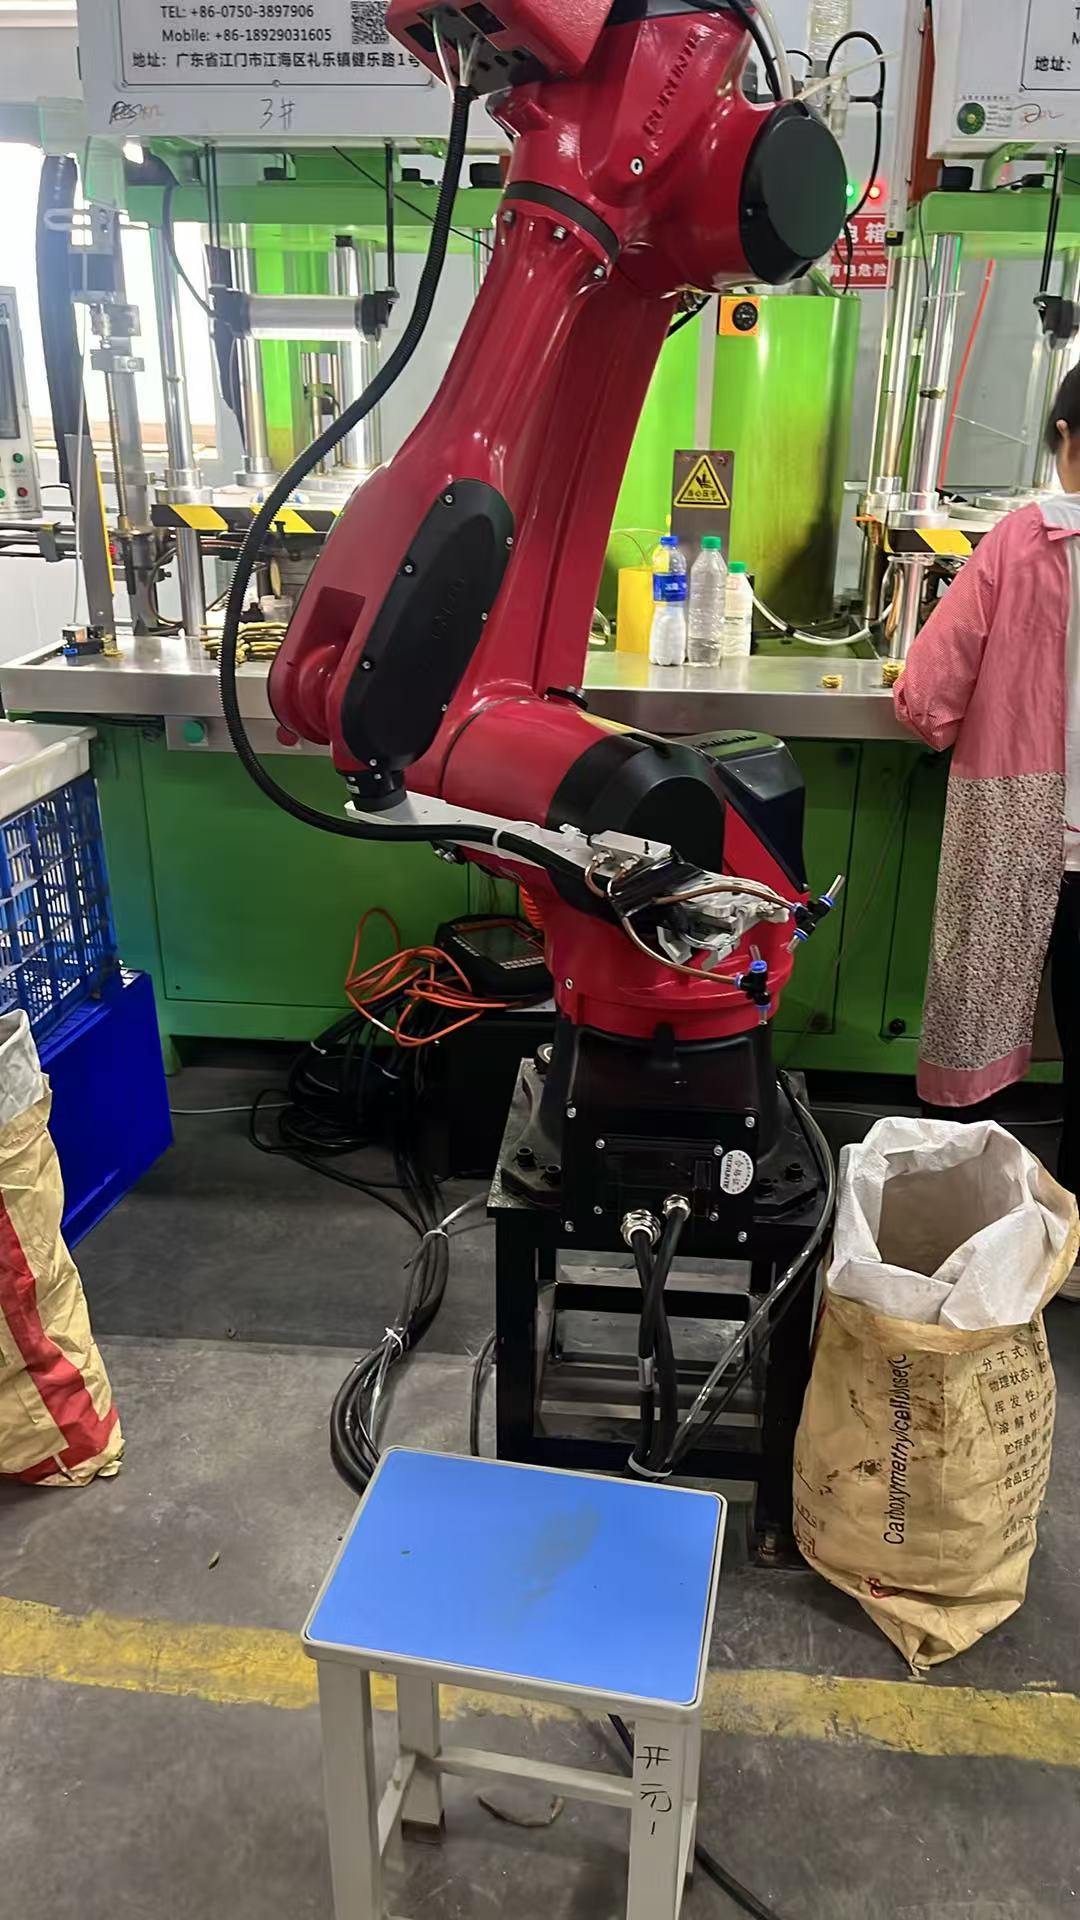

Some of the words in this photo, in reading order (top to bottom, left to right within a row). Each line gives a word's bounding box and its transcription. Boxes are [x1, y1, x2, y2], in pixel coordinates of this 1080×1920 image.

[160, 5, 187, 18] TEL:
[191, 5, 314, 18] +86-0750-3897906
[162, 29, 210, 42] Mobile:
[215, 28, 332, 41] +86-18929031605
